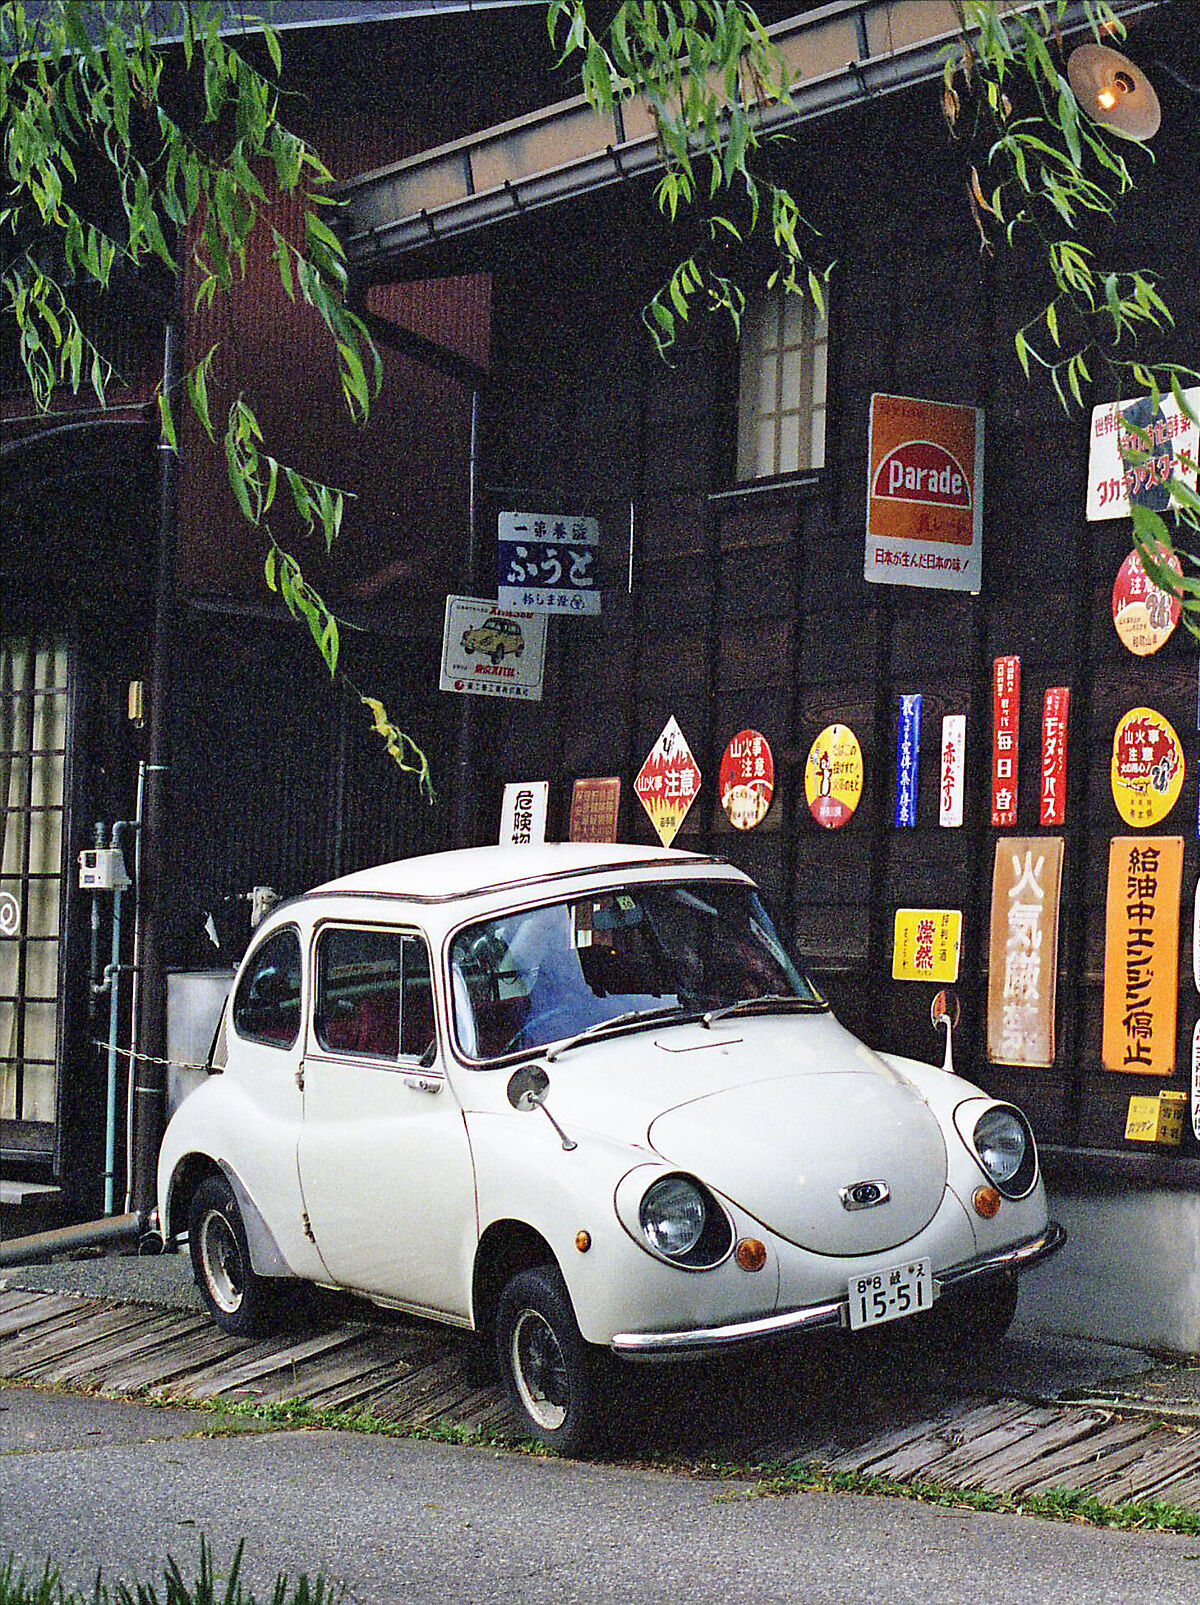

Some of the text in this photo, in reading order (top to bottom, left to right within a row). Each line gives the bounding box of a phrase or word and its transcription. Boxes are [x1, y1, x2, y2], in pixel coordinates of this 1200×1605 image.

[875, 548, 970, 573] 日本が生んだ日本の味!
[730, 737, 763, 758] 山火事
[1125, 729, 1159, 745] 山火事
[1129, 747, 1153, 761] 注意
[741, 757, 766, 778] 注意
[512, 790, 534, 845] 危険物
[1123, 846, 1160, 1067] 給油中エンジン停止
[861, 1280, 923, 1323] 15-51
